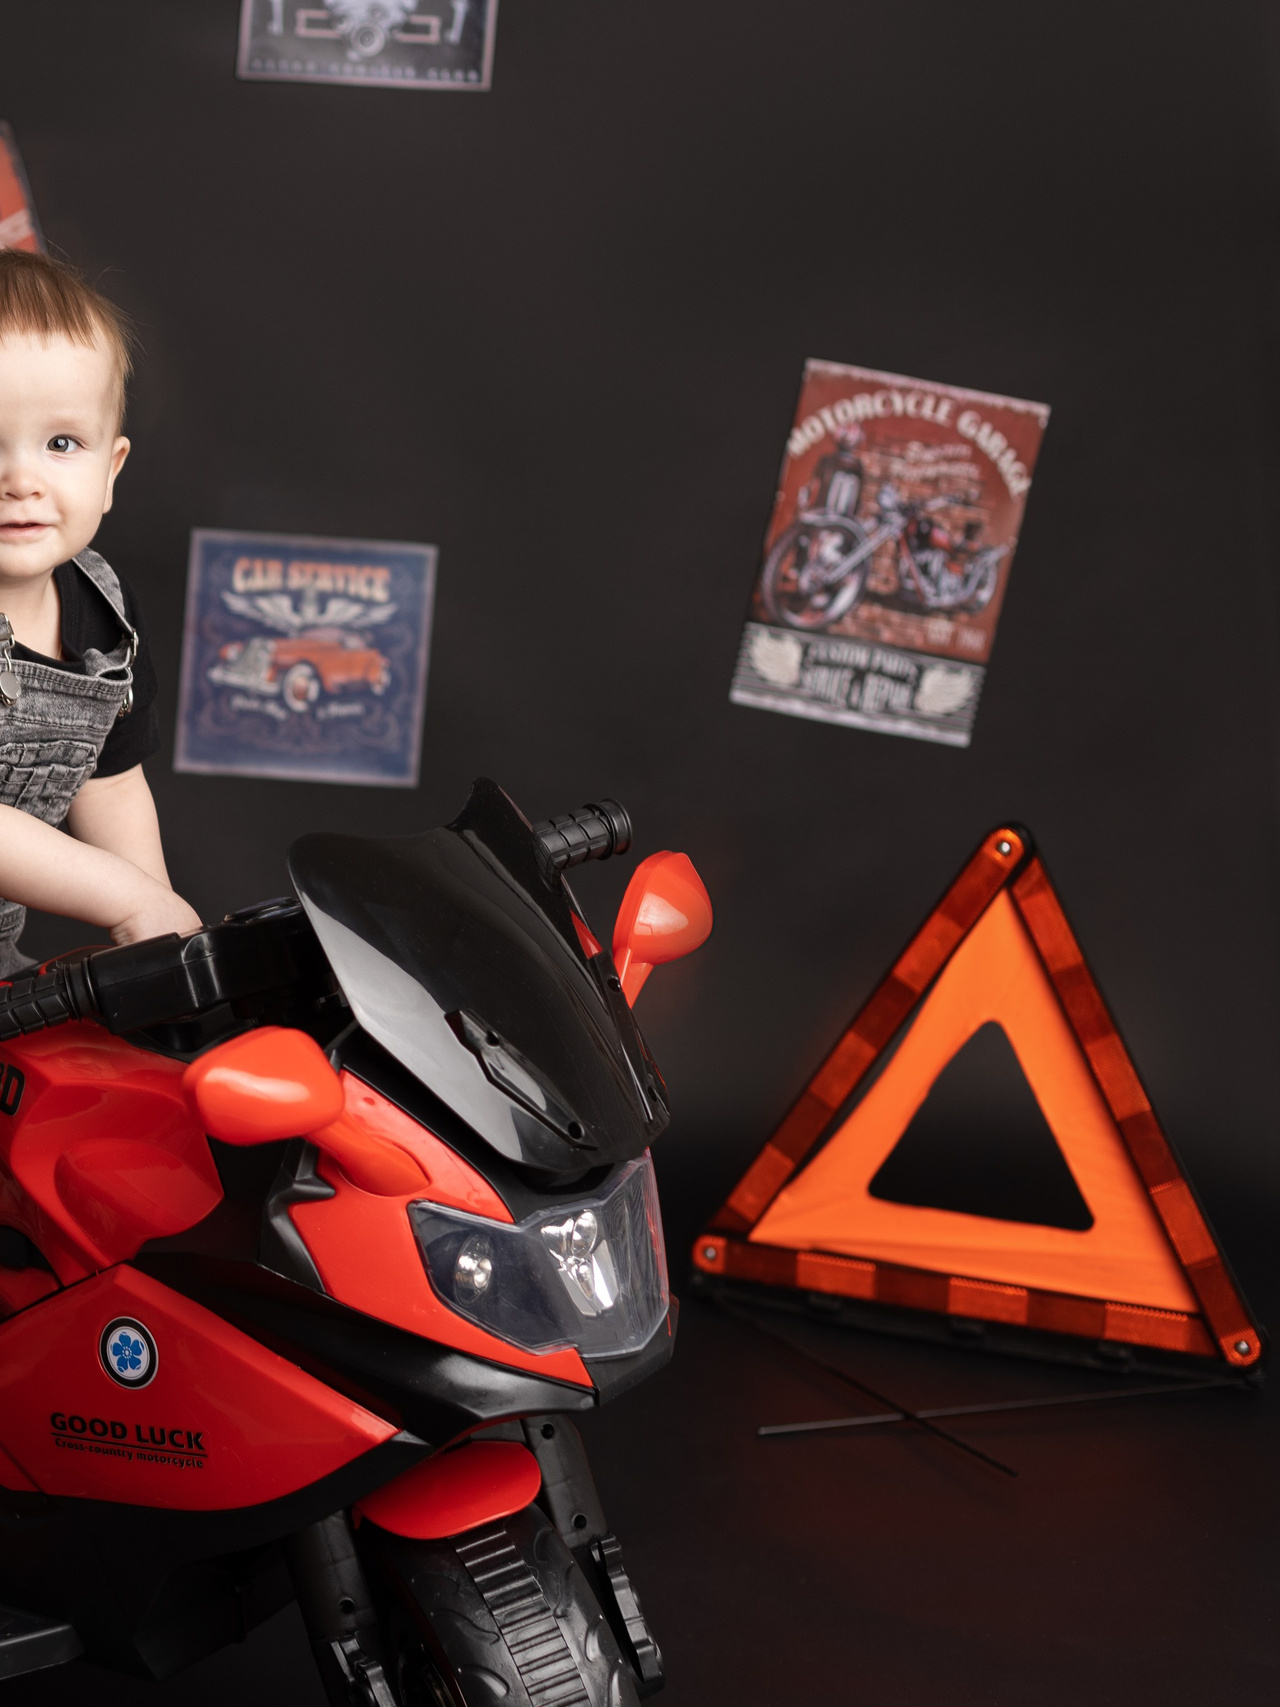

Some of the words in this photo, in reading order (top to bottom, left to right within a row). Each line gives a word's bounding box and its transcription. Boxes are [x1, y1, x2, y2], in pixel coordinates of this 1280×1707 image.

[787, 388, 956, 459] MOTORCYCLE
[232, 556, 284, 593] CAR
[287, 560, 392, 603] SERVICE
[49, 1411, 128, 1441] GOOD
[135, 1424, 206, 1452] LUCK
[54, 1437, 134, 1462] Cross-country
[136, 1451, 204, 1470] motorcycle
